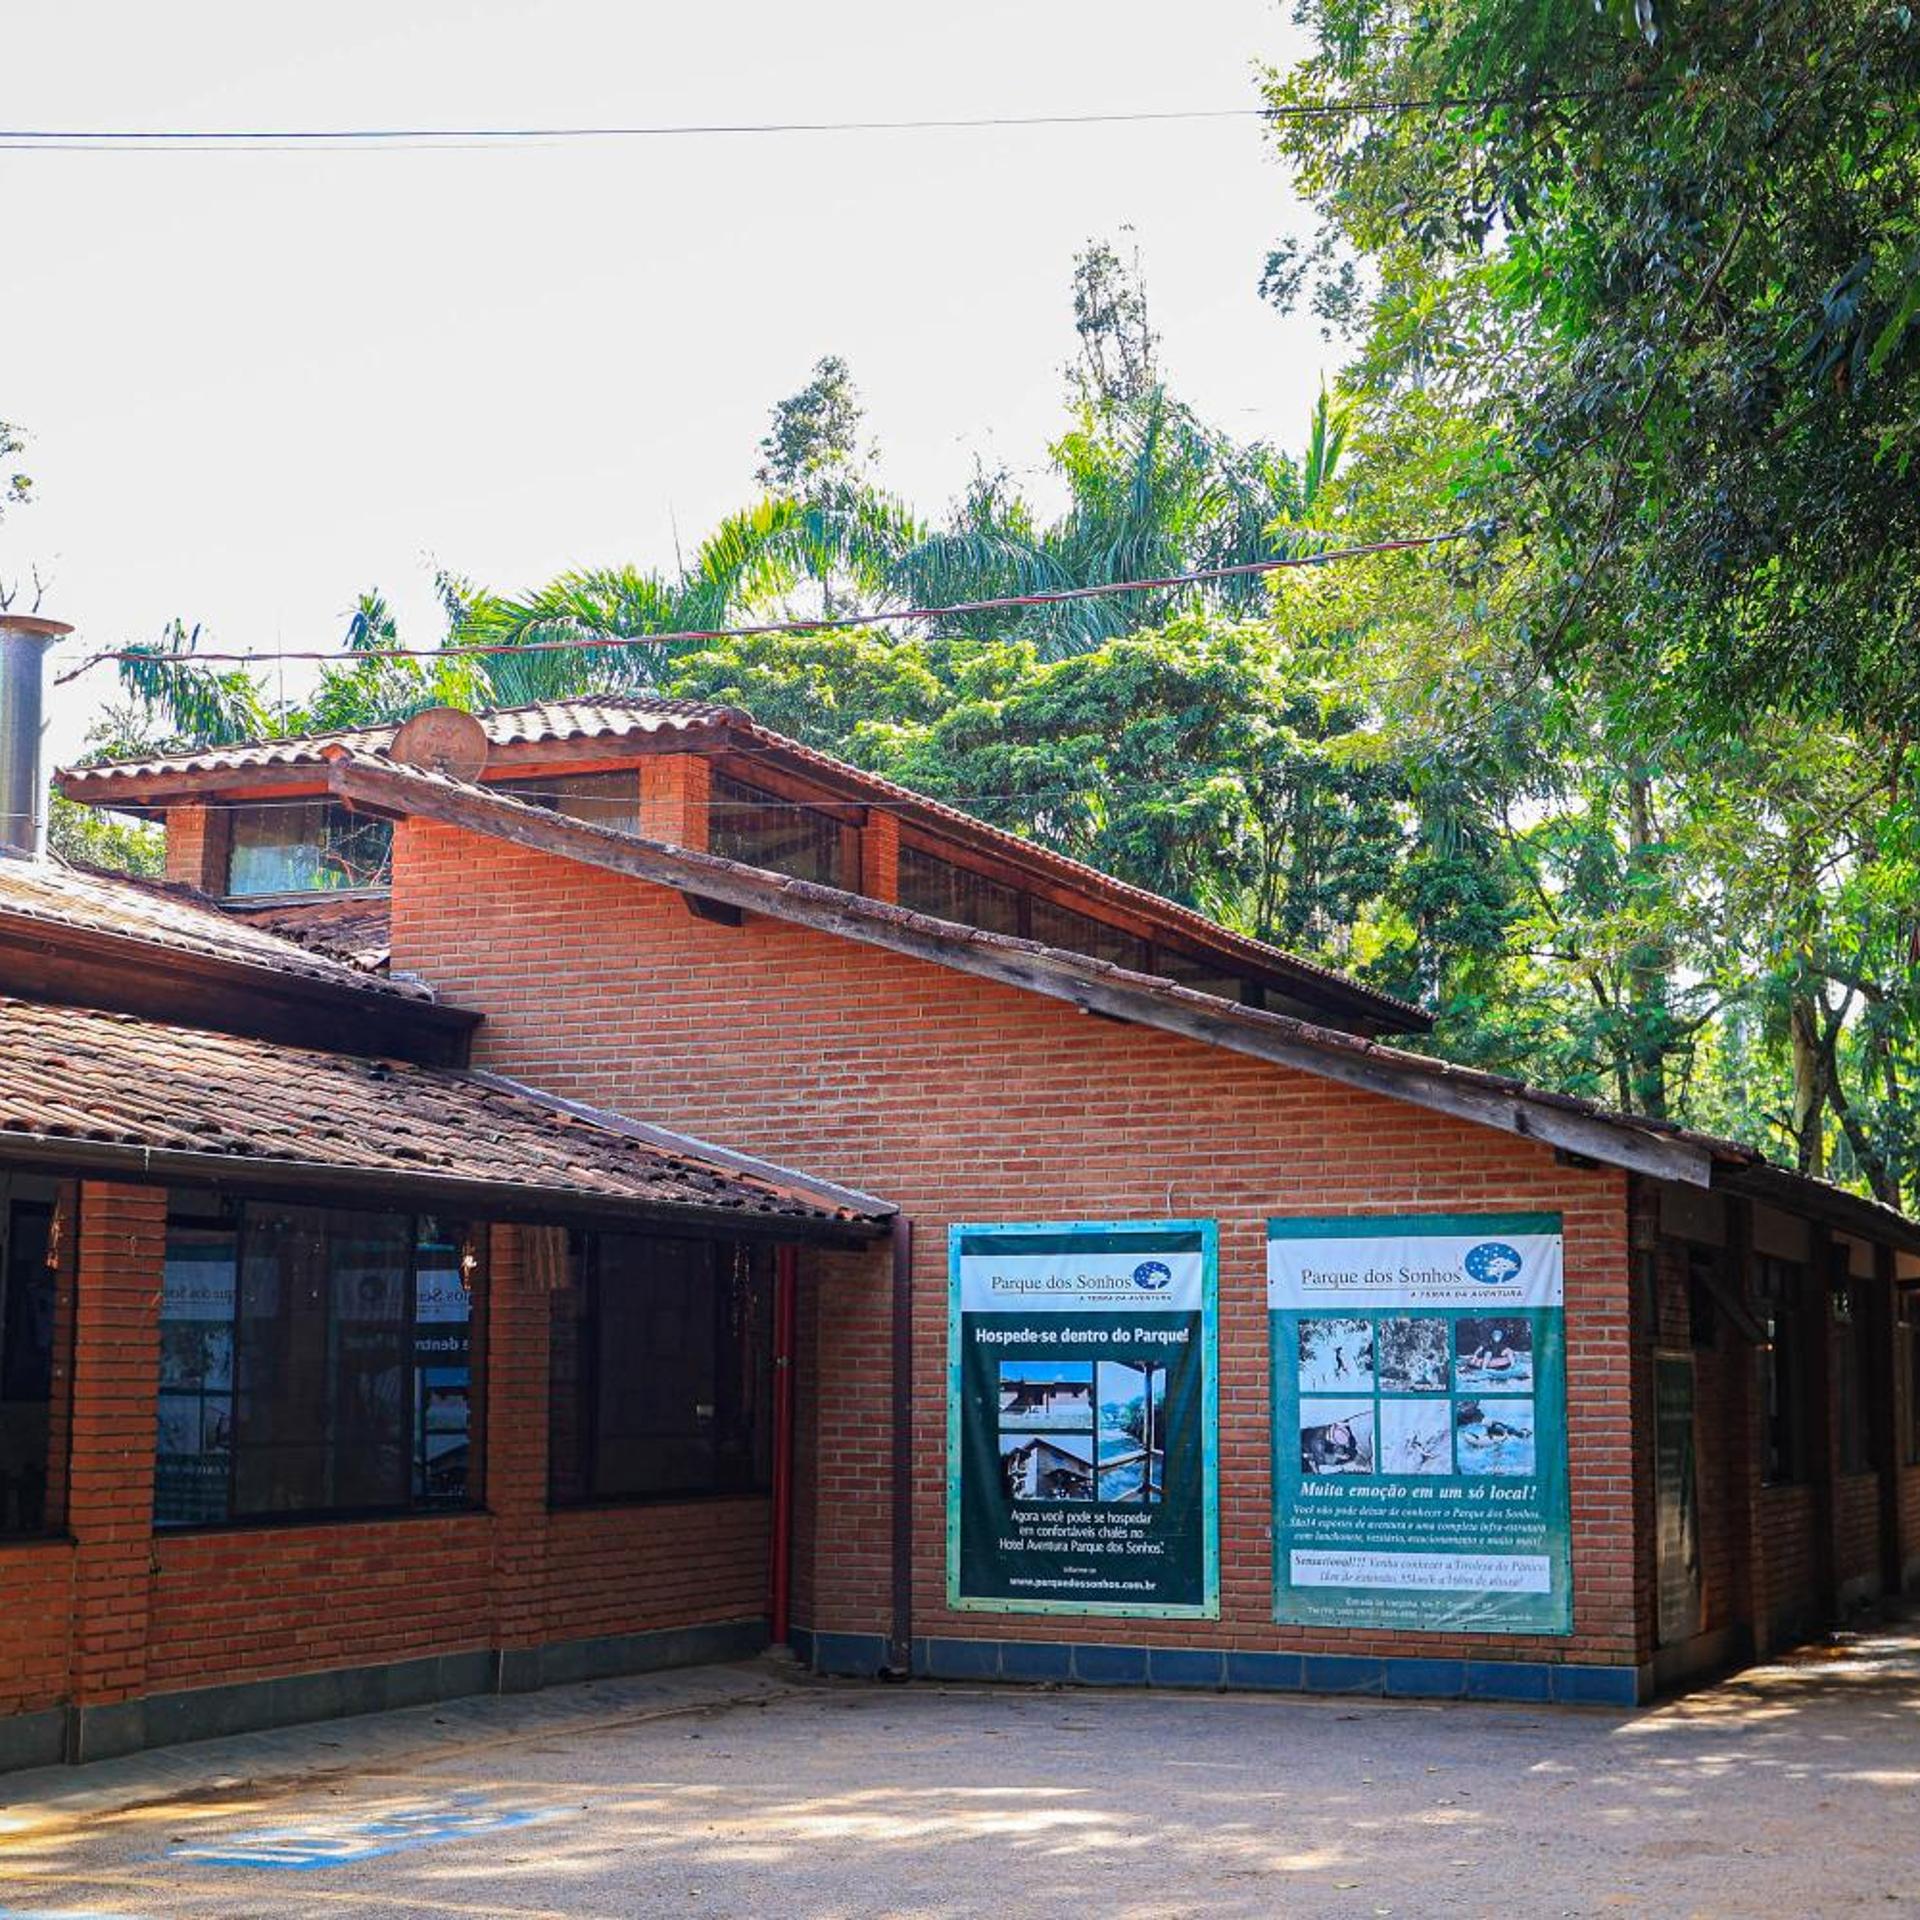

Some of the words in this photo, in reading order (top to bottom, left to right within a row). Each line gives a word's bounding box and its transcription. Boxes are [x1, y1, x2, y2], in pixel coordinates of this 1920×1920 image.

[992, 1276, 1041, 1293] Parque
[1046, 1275, 1071, 1290] dos
[1077, 1274, 1131, 1289] Sonhos
[1301, 1268, 1358, 1288] Parque
[1363, 1267, 1393, 1283] dos
[1399, 1266, 1461, 1283] Sonhos
[976, 1328, 1057, 1345] Hospede-se
[1060, 1328, 1108, 1343] dentro
[1112, 1328, 1131, 1343] do
[1134, 1328, 1189, 1345] Parque!
[1301, 1481, 1344, 1497] Muita
[1349, 1483, 1407, 1501] emoção
[1412, 1486, 1433, 1498] em
[1439, 1487, 1463, 1498] um
[1467, 1484, 1485, 1499] só
[1011, 1509, 1039, 1523] Agora
[1042, 1510, 1064, 1522] você
[1067, 1510, 1091, 1524] pode
[1094, 1513, 1105, 1523] se
[1108, 1511, 1151, 1526] hospedar
[1294, 1504, 1314, 1514] Você
[1317, 1505, 1333, 1514] não
[1335, 1505, 1357, 1517] pode
[1359, 1505, 1387, 1516] deixar
[1389, 1507, 1400, 1516] de
[1402, 1507, 1442, 1517] conhecer
[1453, 1507, 1484, 1519] Parque
[1486, 1508, 1502, 1518] dos
[1019, 1526, 1035, 1537] em
[1037, 1525, 1095, 1538] confortáveis
[1098, 1525, 1127, 1538] chalés
[1130, 1529, 1144, 1538] no
[1355, 1518, 1366, 1529] de
[1367, 1521, 1406, 1530] aventura
[1415, 1522, 1435, 1530] uma
[1437, 1520, 1478, 1533] completa
[1293, 1532, 1314, 1540] com
[1000, 1538, 1023, 1550] Hotel
[1027, 1539, 1068, 1552] Aventura
[1071, 1540, 1104, 1554] Parque
[1106, 1541, 1123, 1553] dos
[1401, 1559, 1443, 1570] conhecer
[1009, 1577, 1157, 1591] www.parquedossonhos.com.br
